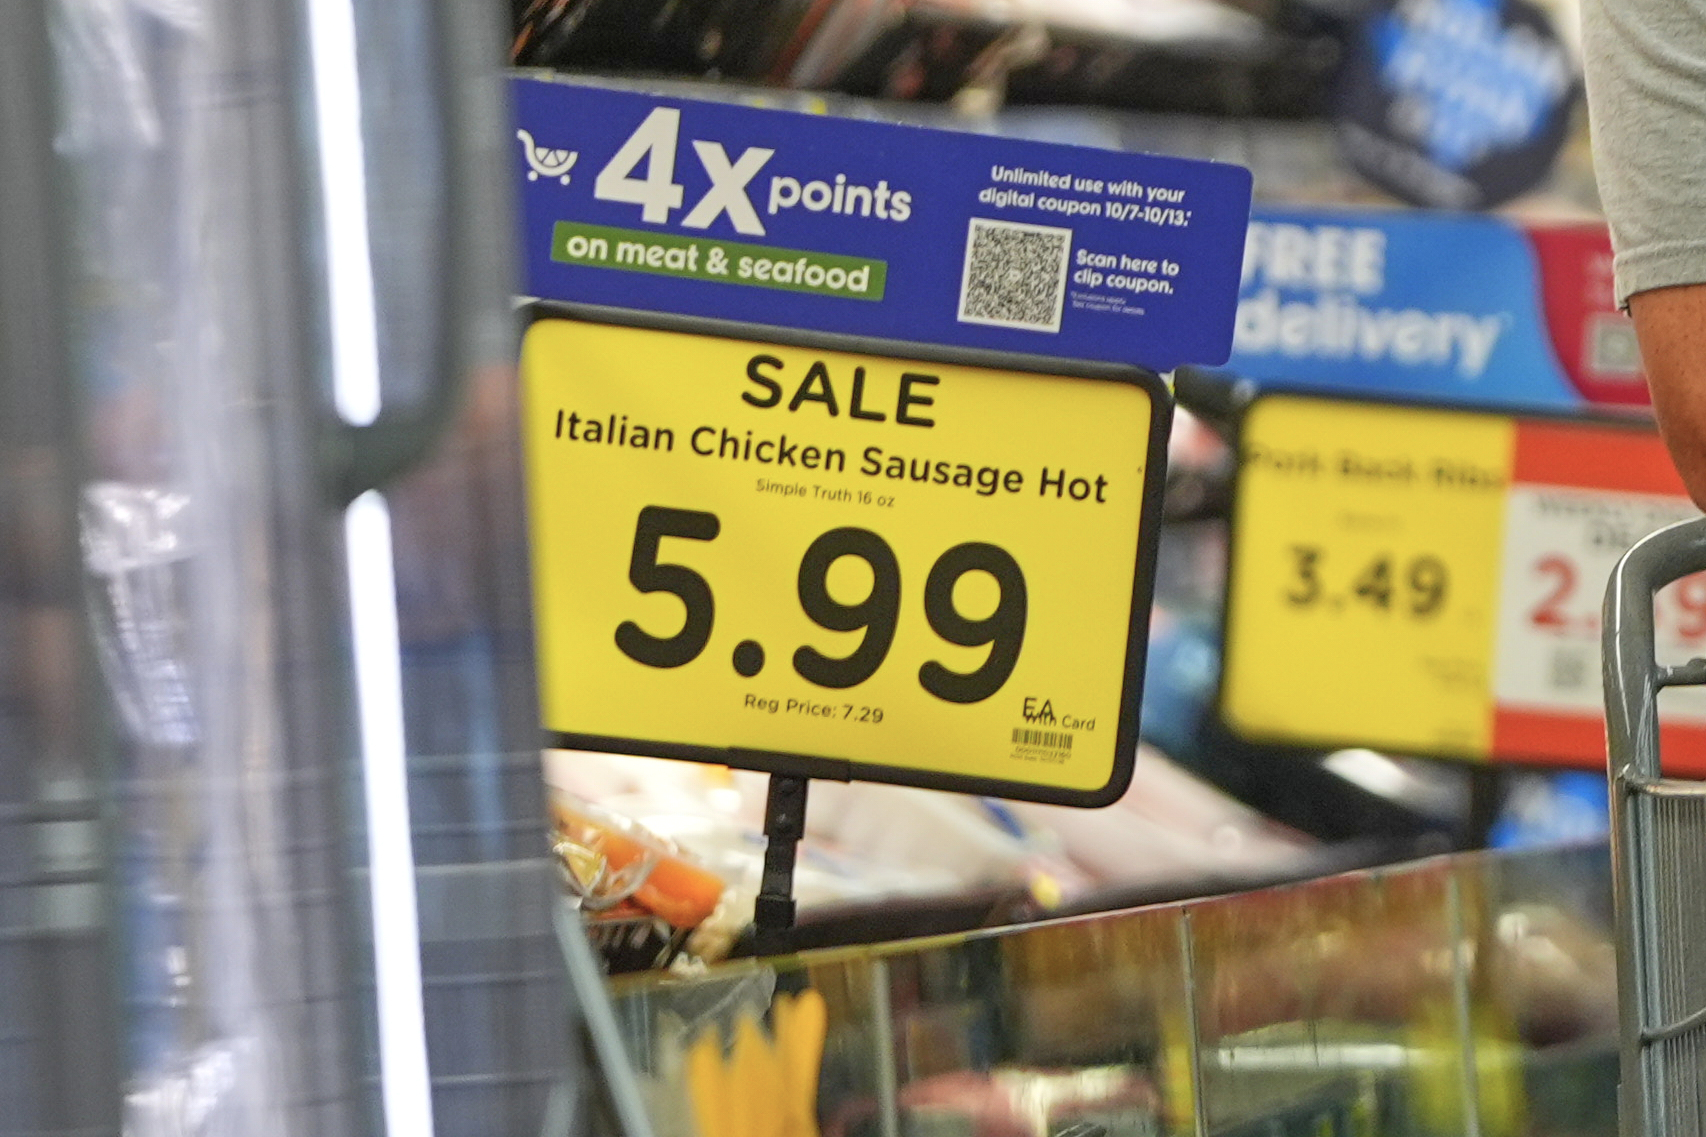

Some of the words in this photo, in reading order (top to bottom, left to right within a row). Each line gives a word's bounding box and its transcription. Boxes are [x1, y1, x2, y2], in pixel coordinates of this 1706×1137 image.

[768, 174, 912, 222] points
[979, 187, 1035, 208] digital
[1037, 196, 1101, 216] coupon
[991, 164, 1072, 190] Unlimited
[1074, 179, 1104, 194] use
[1108, 180, 1143, 198] with
[1146, 186, 1186, 203] your
[567, 235, 607, 260] on
[616, 241, 699, 273] meat
[706, 247, 729, 275] &
[738, 257, 870, 292] seafood
[1076, 249, 1117, 269] Scan
[1120, 252, 1157, 273] here
[1162, 258, 1180, 276] to
[1240, 222, 1387, 295] FREE
[1074, 268, 1103, 288] clip
[1106, 273, 1174, 295] coupon.
[1233, 289, 1501, 378] delivery
[741, 354, 940, 428] SALE
[555, 409, 675, 452] Italian
[691, 426, 846, 473] Chicken
[860, 446, 1024, 496] Sausage
[1039, 466, 1108, 504] Hot
[756, 478, 807, 497] Simple
[813, 485, 852, 502] Truth
[858, 490, 872, 505] 16
[877, 496, 895, 507] oz
[1283, 542, 1449, 622] 3.49
[614, 504, 1028, 704] 5.99
[744, 693, 779, 714] Reg
[786, 698, 837, 717] Price:
[843, 704, 884, 723] 7.29
[1023, 697, 1055, 720] EA
[1062, 714, 1096, 731] Card
